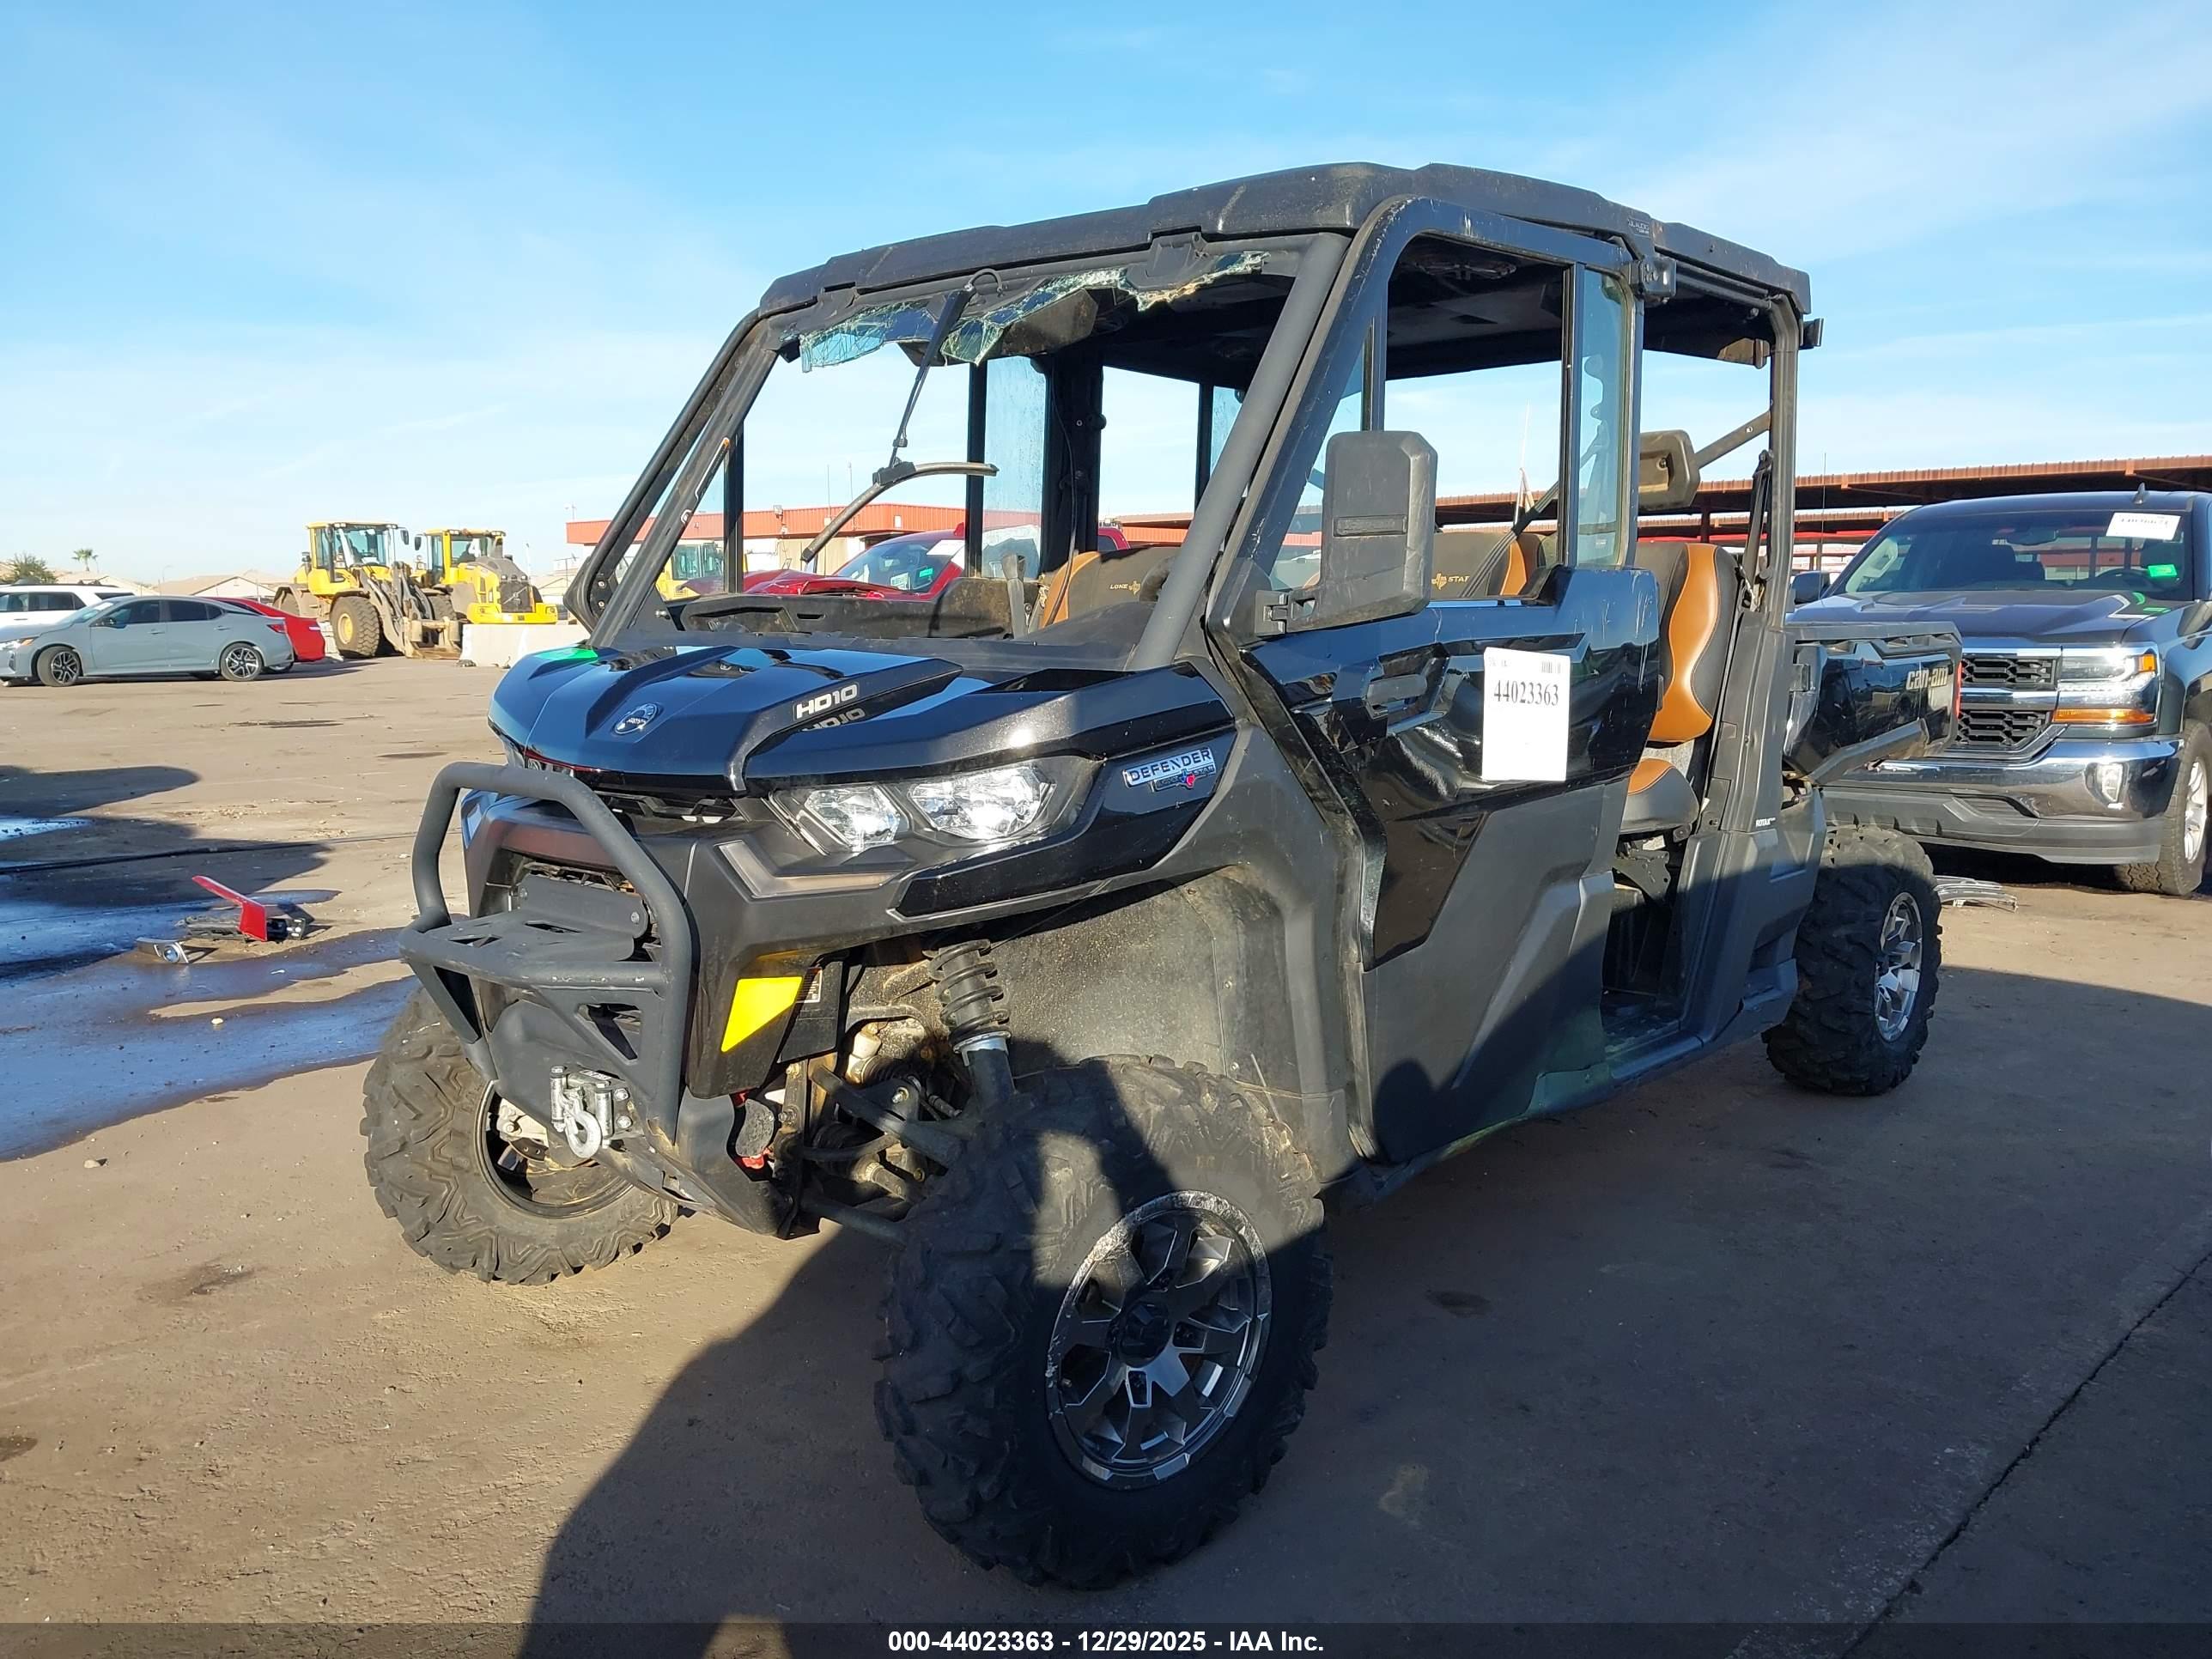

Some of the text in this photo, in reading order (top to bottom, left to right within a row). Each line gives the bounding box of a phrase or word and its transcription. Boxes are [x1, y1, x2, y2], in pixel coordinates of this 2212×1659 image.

[468, 538, 482, 558] 4
[1905, 666, 1948, 690] can-am
[796, 684, 858, 720] HD10
[1493, 679, 1559, 706] 44023363
[1128, 746, 1212, 781] DEFENDER
